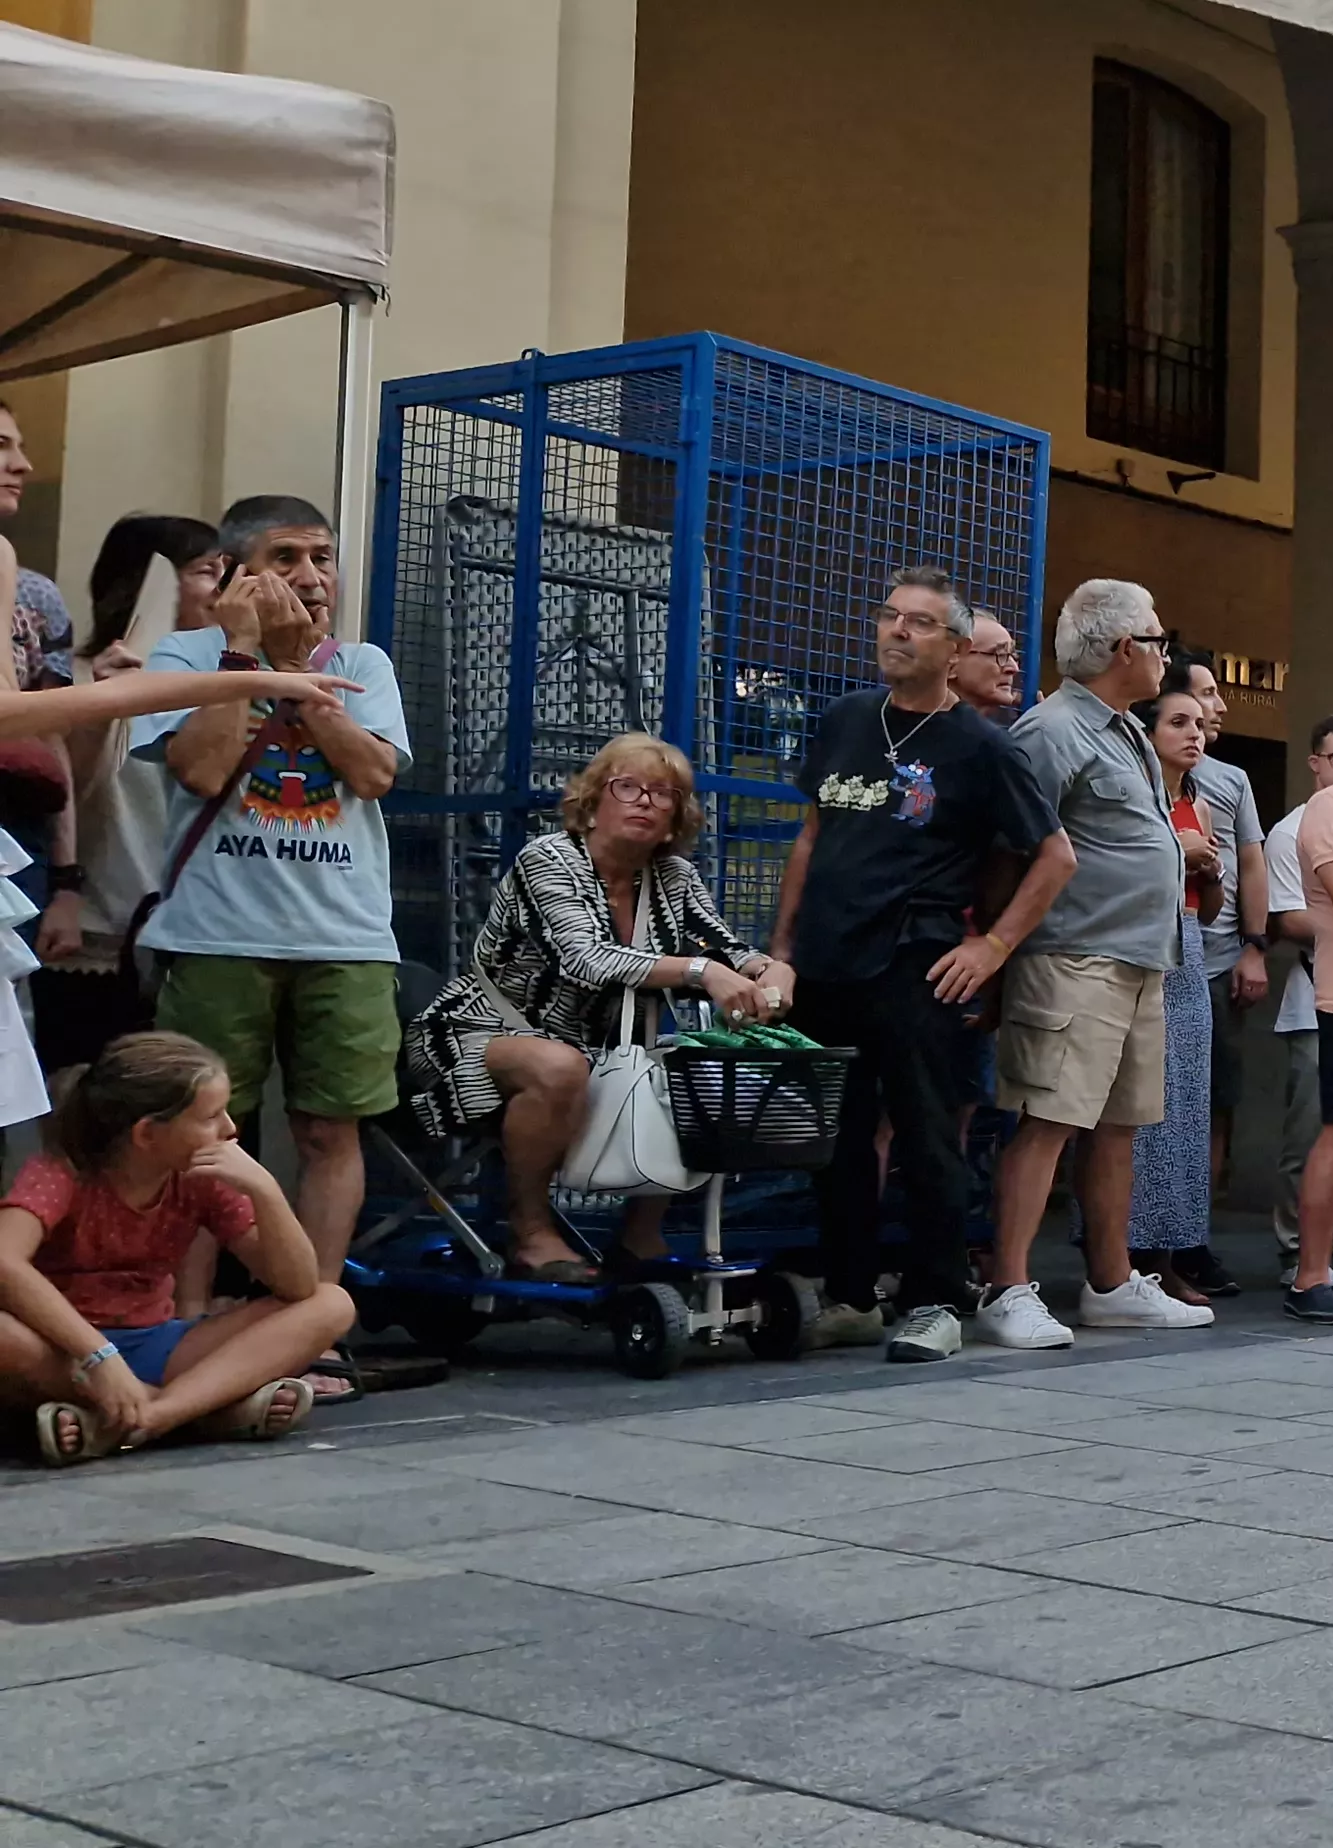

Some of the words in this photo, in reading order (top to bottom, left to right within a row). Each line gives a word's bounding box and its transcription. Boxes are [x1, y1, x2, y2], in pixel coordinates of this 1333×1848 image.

[1213, 651, 1290, 692] mar
[214, 835, 268, 858] AYA
[276, 838, 352, 864] HUMA
